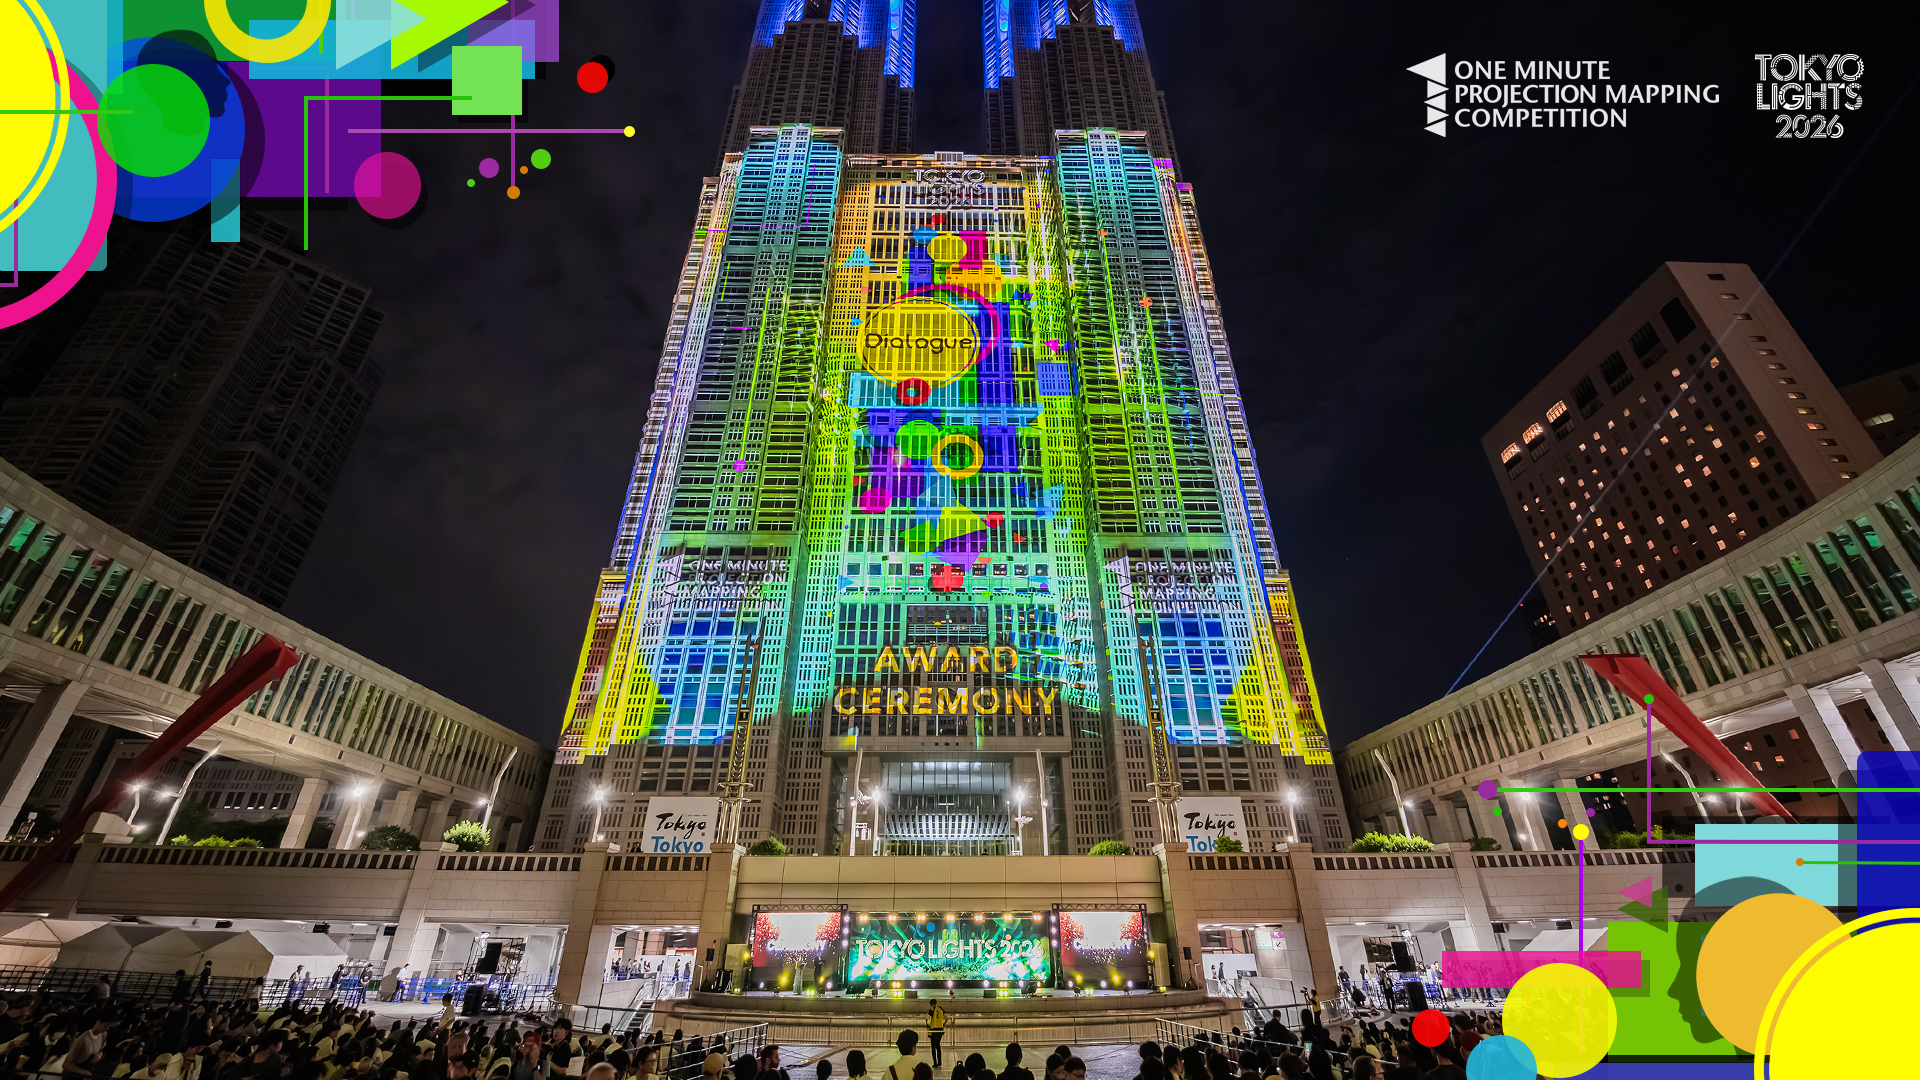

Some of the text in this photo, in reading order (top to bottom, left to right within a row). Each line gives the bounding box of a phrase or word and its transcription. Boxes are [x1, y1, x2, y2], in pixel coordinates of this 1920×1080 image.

[864, 333, 973, 355] Dialogue
[688, 559, 787, 571] ONE MINUTE
[1135, 561, 1234, 573] ONE MINUTE
[688, 573, 786, 586] PROJECTION
[1137, 575, 1236, 588] PROJECTION
[684, 586, 761, 598] MAPPING
[1140, 587, 1216, 599] MAPPING
[874, 646, 1019, 673] AWARD
[834, 687, 1058, 715] CEREMONY
[655, 812, 707, 840] Tokyo
[1184, 812, 1236, 838] Tokyo
[651, 836, 704, 854] Tokyo
[855, 939, 1045, 959] TOKYO LIGHTS 2026
